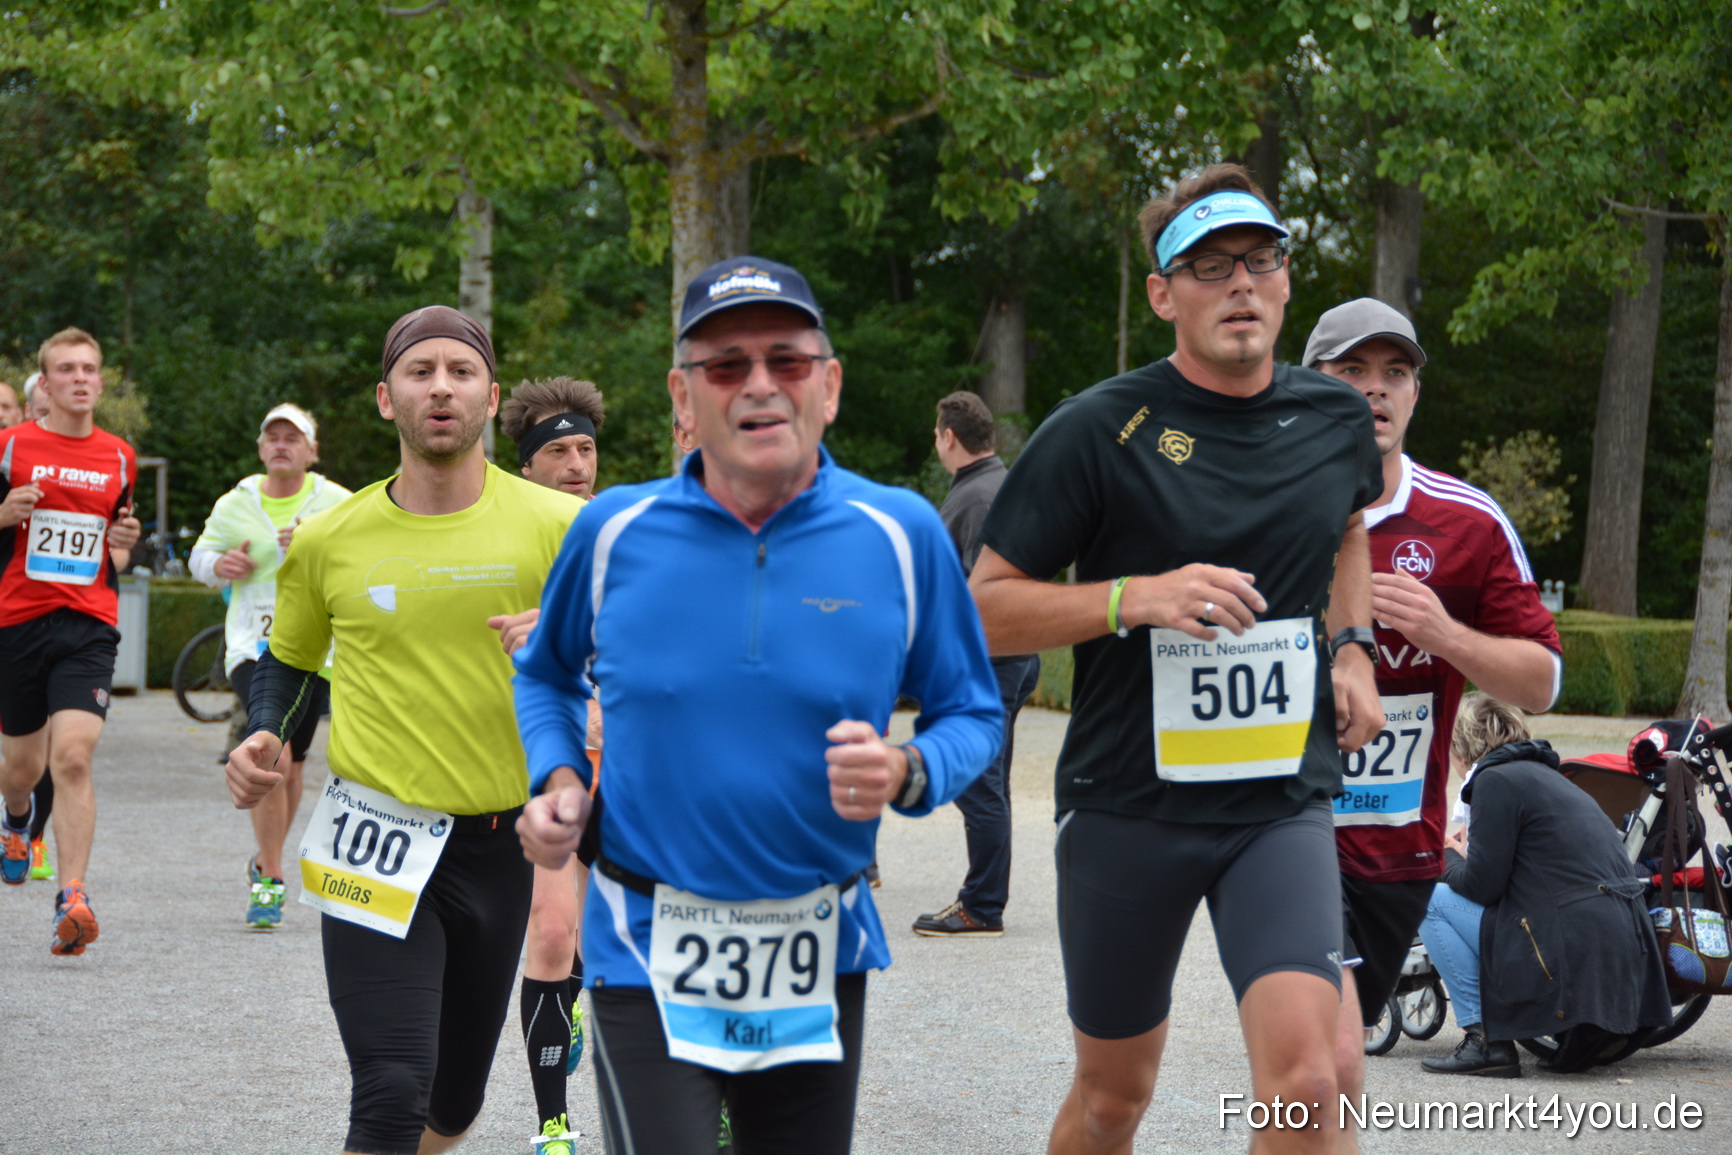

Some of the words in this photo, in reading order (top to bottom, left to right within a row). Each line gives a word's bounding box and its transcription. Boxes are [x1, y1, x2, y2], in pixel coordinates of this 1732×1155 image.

[33, 514, 59, 525] PARTL
[61, 518, 95, 530] Neumarkt
[37, 527, 98, 557] 2197
[1407, 542, 1419, 557] 1.
[57, 561, 75, 573] Tim
[1396, 556, 1430, 572] FCN
[452, 573, 488, 582] Neumarkt
[261, 615, 272, 637] 2
[1157, 643, 1212, 658] PARTL
[1216, 637, 1289, 656] Neumarkt
[1191, 661, 1290, 721] 504
[1384, 710, 1412, 722] arkt
[1341, 728, 1422, 777] 627
[1341, 791, 1389, 809] Peter
[357, 800, 424, 829] Neumarkt
[332, 812, 412, 876] 100
[321, 873, 372, 904] Tobias
[659, 904, 723, 924] PARTL
[673, 930, 819, 1001] 2379
[724, 1017, 773, 1045] Karl
